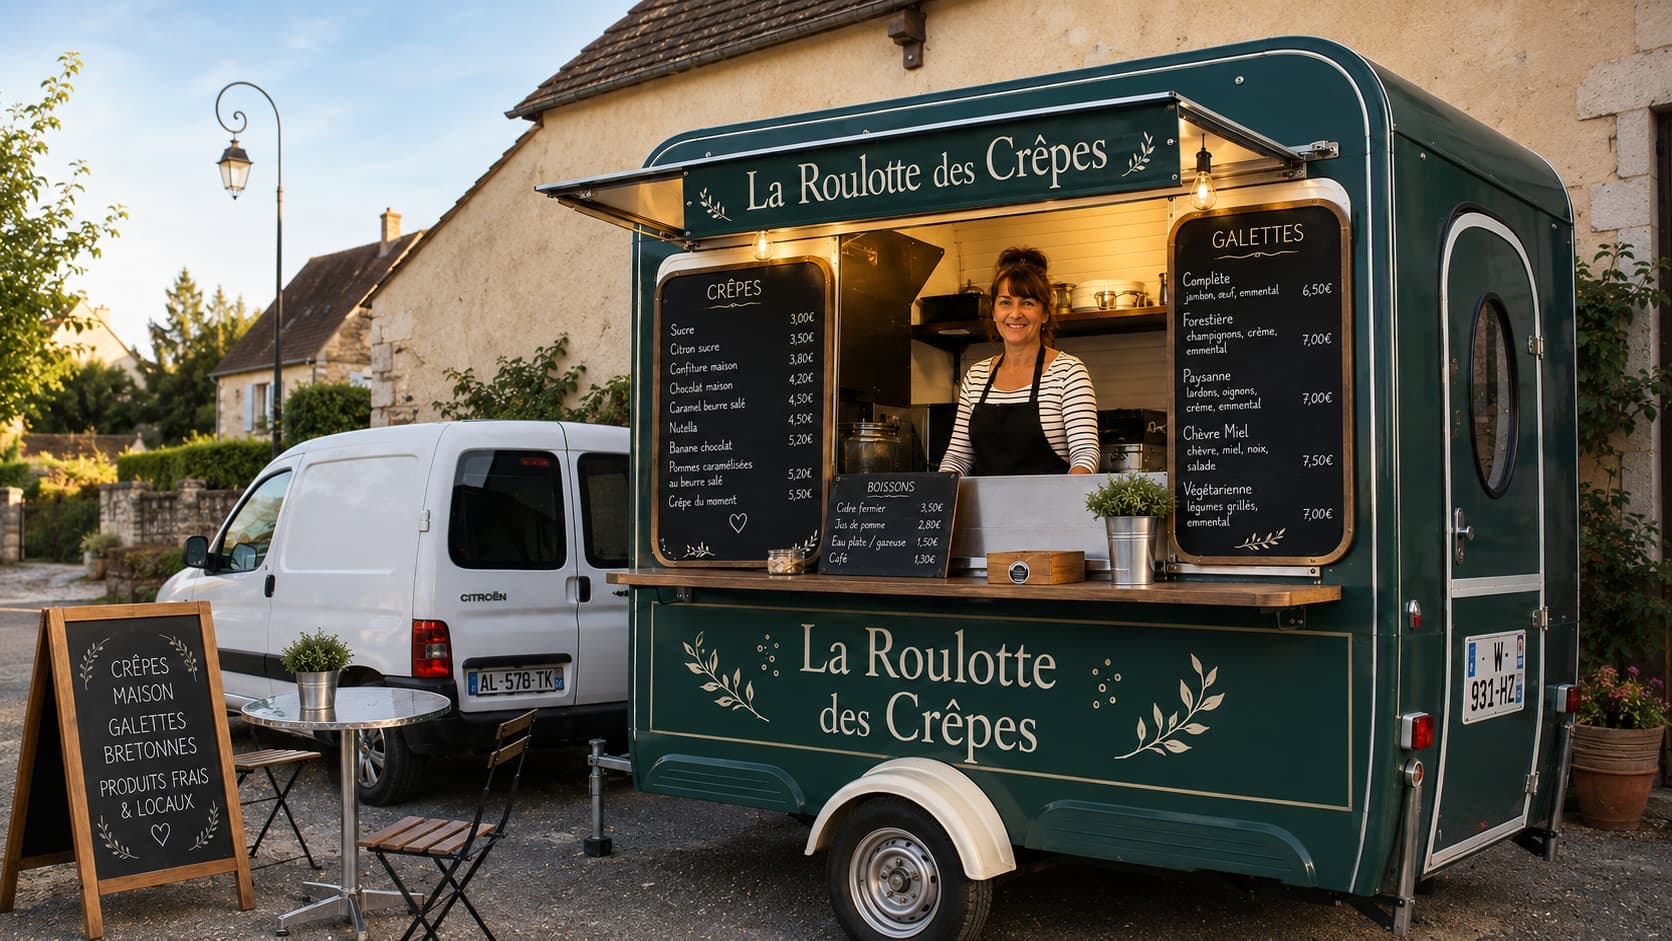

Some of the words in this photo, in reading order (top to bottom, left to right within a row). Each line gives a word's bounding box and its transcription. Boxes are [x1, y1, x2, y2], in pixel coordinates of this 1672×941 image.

[746, 171, 785, 211] La
[798, 154, 921, 205] Roulotte
[933, 152, 975, 187] des
[985, 134, 1107, 190] Crêpes
[1212, 224, 1304, 248] GALETTES
[707, 279, 761, 300] CRÊPES
[1183, 271, 1230, 289] Complète
[1184, 289, 1216, 304] jambon,
[1218, 287, 1237, 299] œuf,
[1239, 284, 1279, 297] emmental
[1302, 283, 1332, 297] 6,50€
[670, 323, 695, 336] Sucre
[790, 312, 815, 325] 3,00€
[1183, 312, 1233, 327] Forestière
[670, 343, 695, 356] Citron
[698, 343, 720, 353] sucre
[790, 332, 815, 345] 3,50€
[1186, 330, 1244, 344] champignons,
[1247, 327, 1278, 337] crème,
[1186, 342, 1227, 355] emmental
[1302, 333, 1332, 347] 7,00€
[670, 362, 707, 376] Confiture
[710, 362, 738, 372] maison
[789, 353, 814, 365] 3,80€
[670, 381, 703, 395] Chocolat
[706, 382, 734, 391] maison
[789, 373, 814, 385] 4,20€
[1183, 369, 1231, 387] Paysanne
[669, 401, 702, 414] Caramel
[703, 400, 728, 411] beurre
[730, 398, 746, 409] salé
[788, 393, 814, 407] 4,50€
[1186, 387, 1220, 398] lardons,
[1222, 387, 1258, 400] oignons,
[1302, 392, 1332, 406] 7,00€
[1218, 398, 1262, 411] emmental
[669, 422, 698, 433] Nutella
[788, 413, 813, 426] 4,50€
[1183, 425, 1220, 440] Chèvre
[1224, 423, 1249, 439] Miel
[669, 441, 698, 454] Banane
[701, 440, 733, 452] chocolat
[788, 433, 813, 447] 5,20€
[1187, 444, 1219, 456] chèvre,
[1222, 442, 1243, 455] miel,
[1247, 443, 1269, 454] noix,
[1303, 455, 1333, 468] 7,50€
[669, 460, 700, 473] Pommes
[703, 459, 753, 471] caramélisées
[1187, 459, 1216, 472] salade
[669, 479, 678, 488] au
[680, 476, 705, 487] beurre
[707, 474, 723, 486] salé
[787, 468, 812, 481] 5,20€
[867, 481, 915, 493] BOISSONS
[694, 495, 704, 506] du
[706, 495, 737, 506] moment
[788, 488, 813, 501] 5,50€
[1183, 481, 1252, 500] Végétarienne
[836, 502, 856, 513] Cidre
[859, 502, 886, 515] fermier
[1187, 501, 1223, 516] légumes
[1227, 499, 1258, 515] grillés,
[1187, 516, 1230, 527] emmental
[1303, 508, 1333, 522] 7,00€
[850, 519, 858, 529] de
[860, 522, 886, 533] pomme
[832, 535, 846, 547] Eau
[848, 536, 867, 550] plate
[868, 535, 876, 548] /
[876, 539, 906, 551] gazeuse
[829, 552, 848, 565] Café
[460, 591, 507, 602] CITROËN
[110, 654, 169, 678] CRÊPES
[800, 624, 850, 676] La
[865, 628, 1057, 690] Roulotte
[113, 683, 174, 704] MAISON
[1471, 675, 1515, 711] 931-HZ
[108, 712, 187, 737] GALETTES
[820, 692, 870, 737] des
[886, 691, 1038, 764] Crêpes
[103, 737, 197, 765] BRETONNES
[99, 772, 166, 797] PRODUITS
[171, 768, 209, 788] FRAIS
[120, 801, 132, 819] &
[137, 793, 195, 816] LOCAUX
